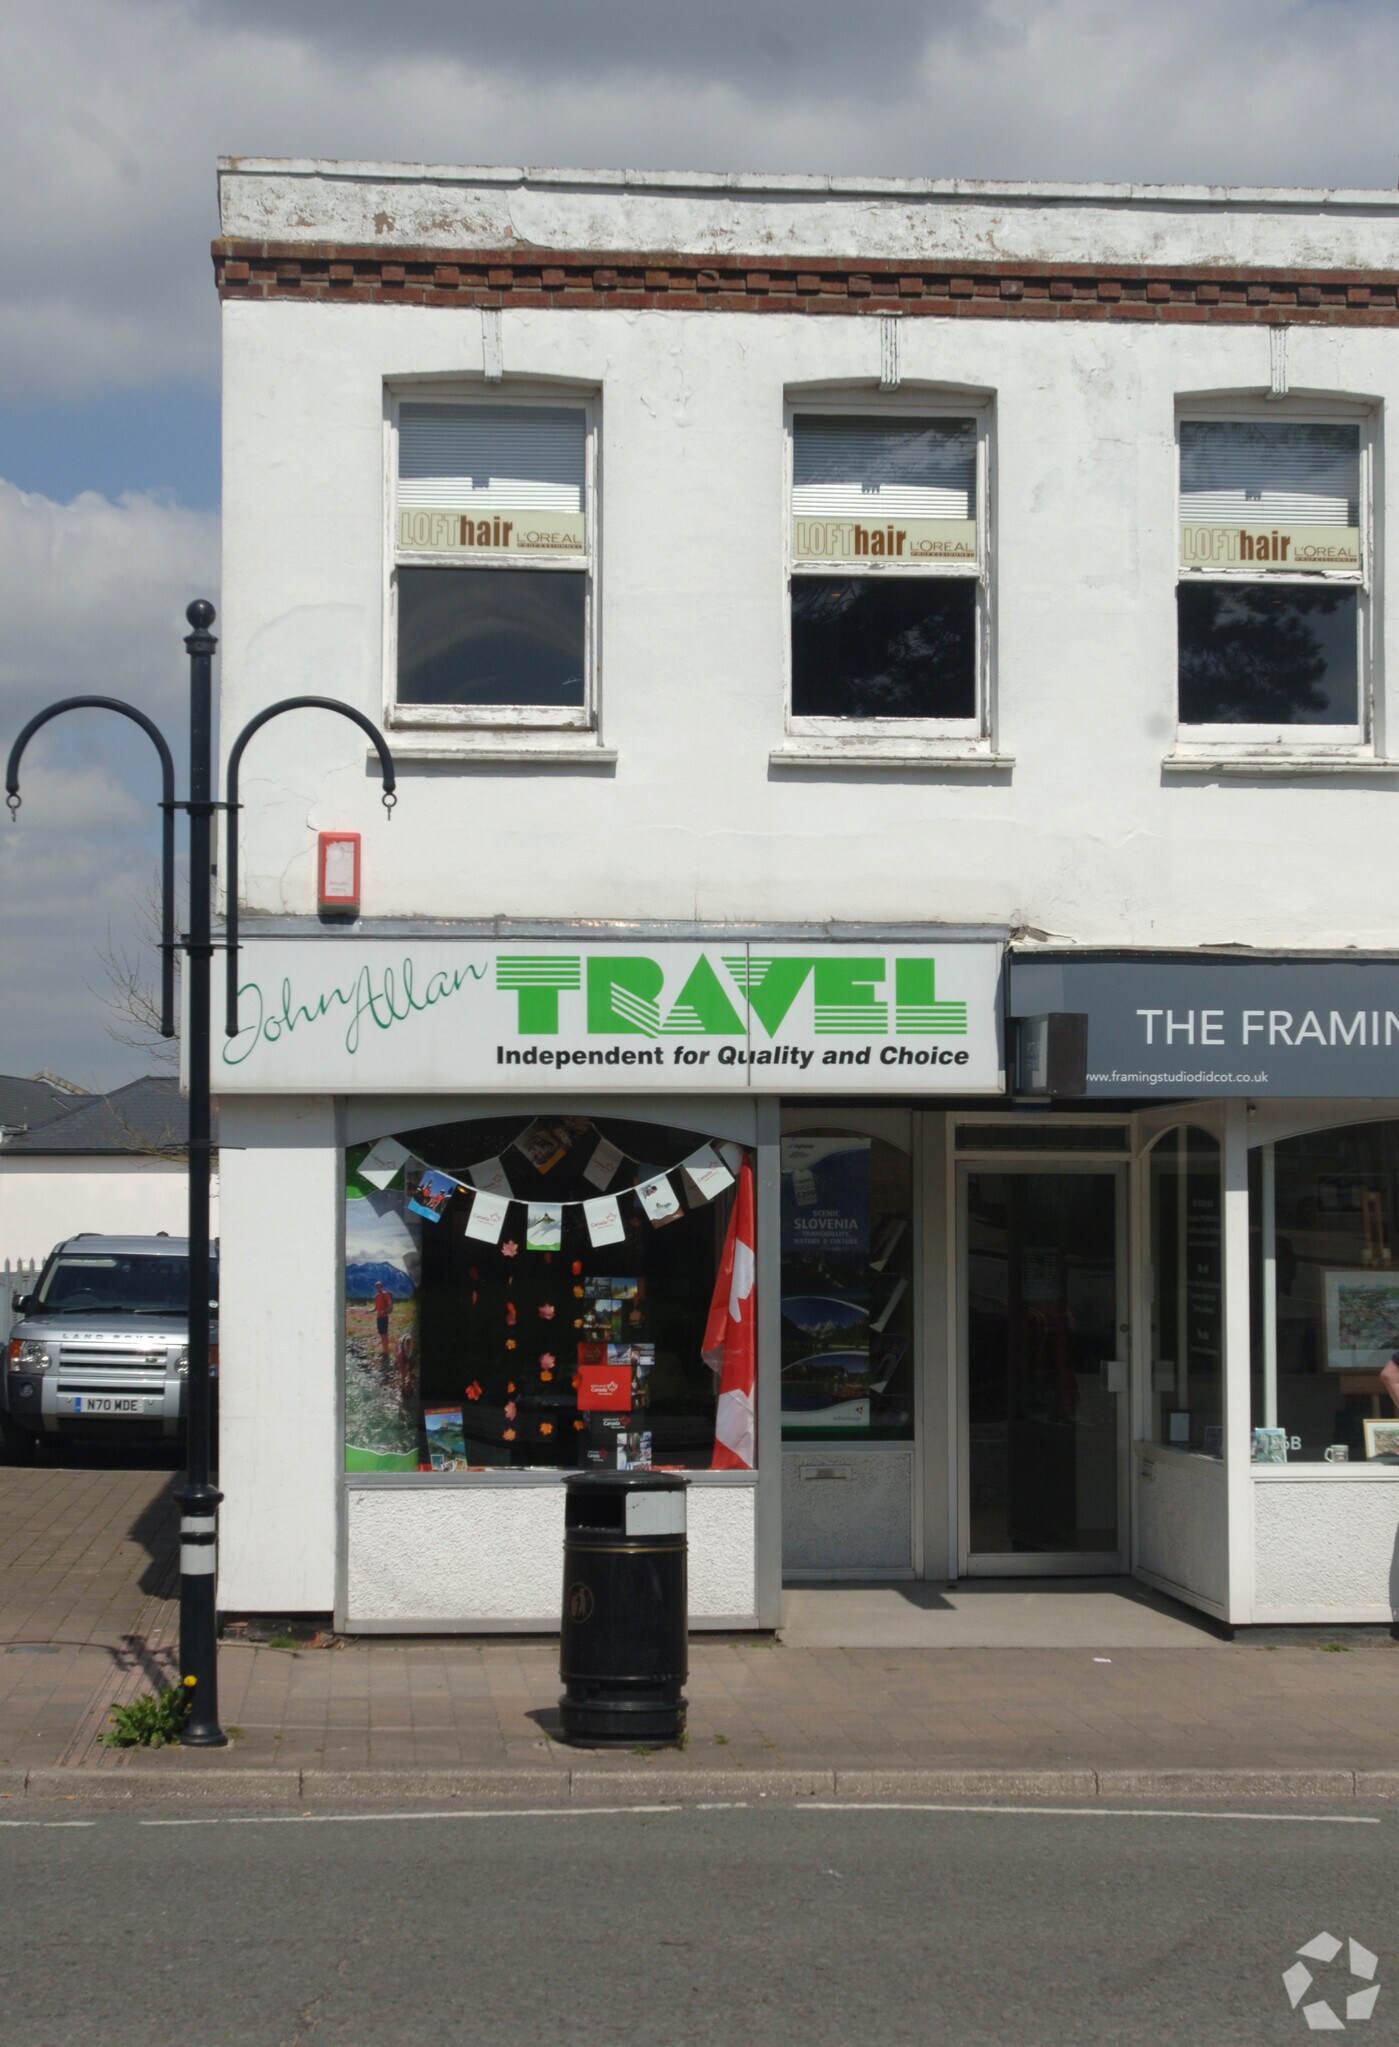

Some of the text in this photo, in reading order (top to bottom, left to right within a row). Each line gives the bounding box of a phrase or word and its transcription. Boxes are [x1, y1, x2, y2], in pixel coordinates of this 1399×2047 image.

[223, 952, 967, 1065] John Allan TRAVEL
[1136, 1009, 1225, 1045] THE
[496, 1045, 970, 1069] Independent for Quality and Choice
[812, 1209, 841, 1217] SCENIC
[793, 1218, 859, 1230] SLOVENIA
[87, 1399, 111, 1411] N70
